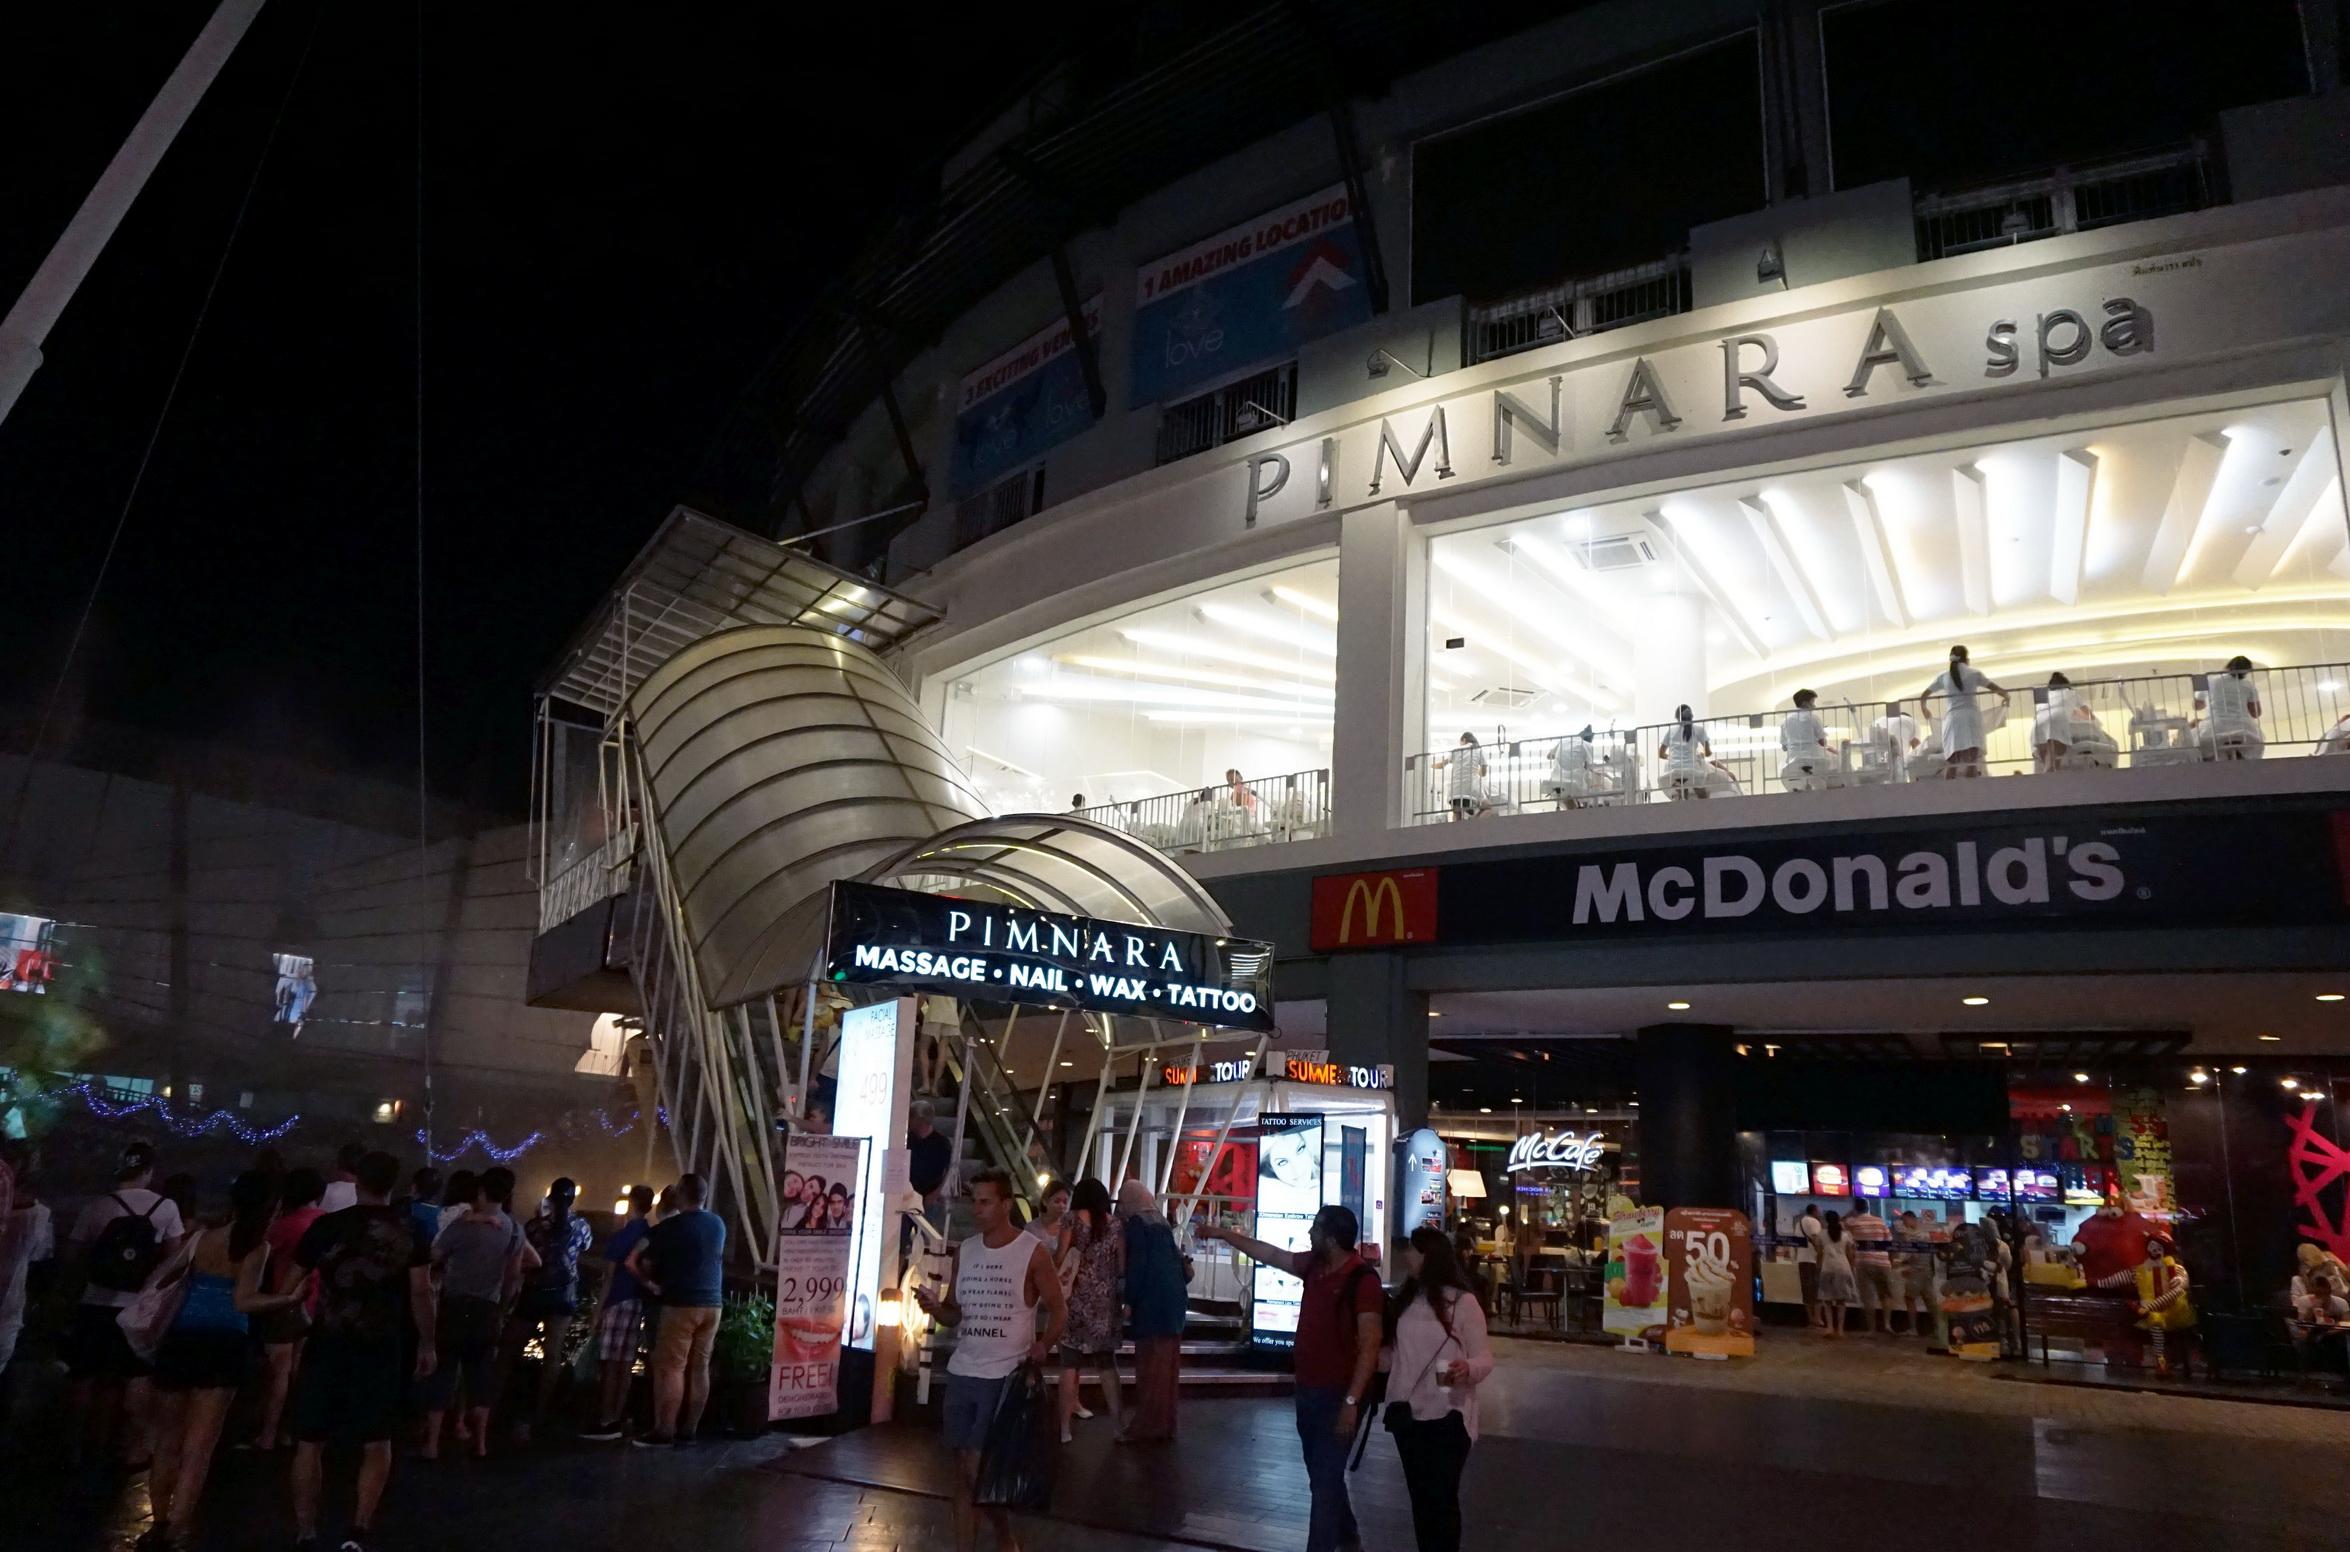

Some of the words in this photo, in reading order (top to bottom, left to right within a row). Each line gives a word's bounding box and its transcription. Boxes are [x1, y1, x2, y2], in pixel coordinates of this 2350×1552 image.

[1145, 276, 1154, 298] 1
[1159, 237, 1252, 293] AMAZING
[1166, 327, 1225, 369] love
[1245, 304, 1932, 528] PIMNARA
[1983, 297, 2154, 379] spa
[1572, 835, 2125, 924] McDonald's
[949, 911, 1183, 972] PIMNARA
[855, 945, 987, 982] MASSAGE
[1010, 963, 1068, 992] NAIL
[1090, 974, 1147, 1001] WAX
[1167, 983, 1256, 1013] TATTOO
[1215, 1060, 1250, 1082] TOUR
[1350, 1066, 1388, 1089] TOUR
[1261, 1118, 1287, 1126] TATTOO
[1289, 1118, 1322, 1127] SERVICES
[1507, 1131, 1604, 1172] McCafé
[784, 1277, 845, 1308] 2,999
[1262, 1337, 1274, 1345] offer
[1285, 1340, 1295, 1348] spe
[779, 1363, 834, 1391] FREE!
